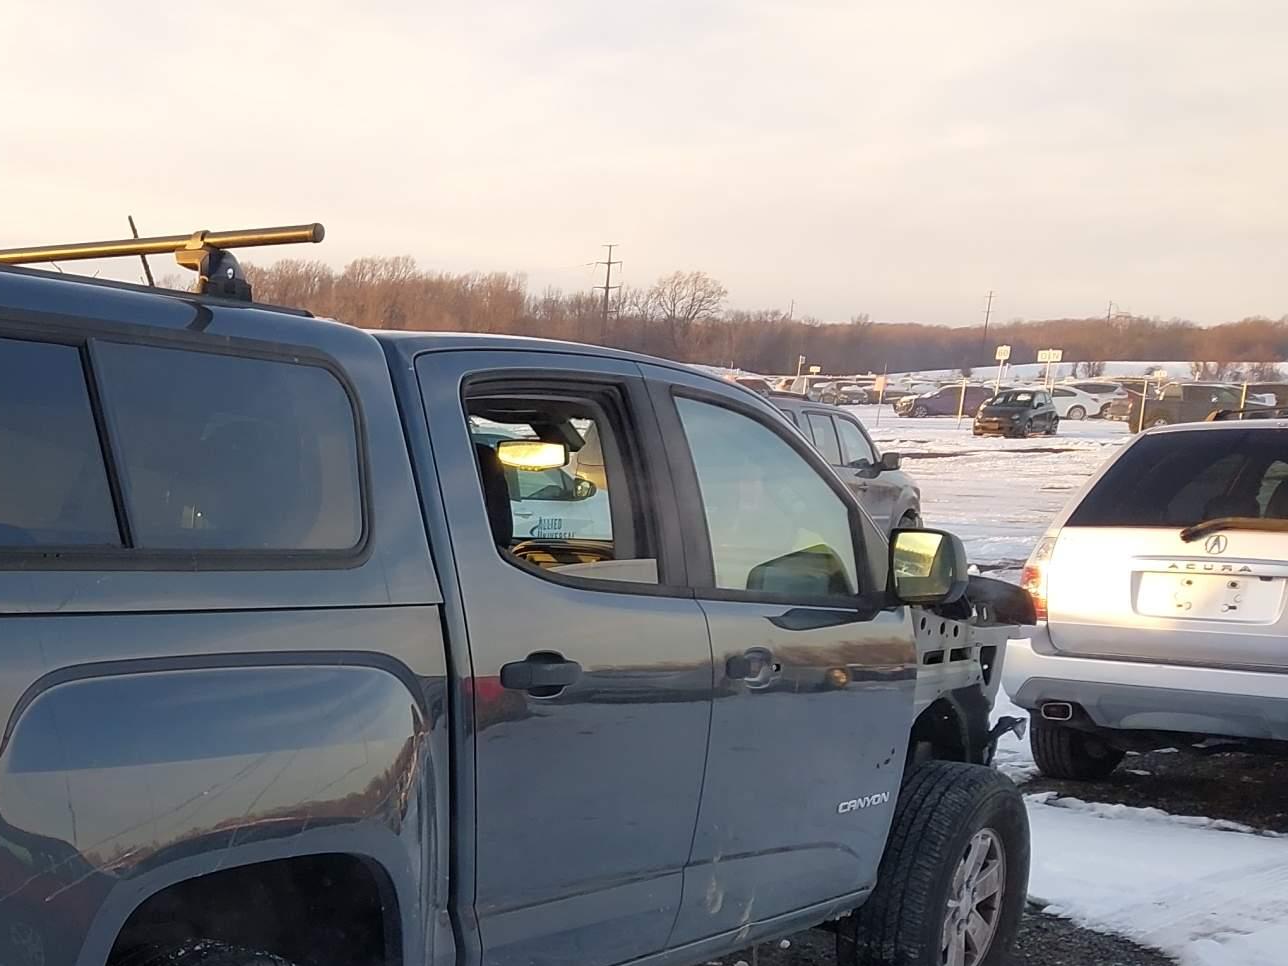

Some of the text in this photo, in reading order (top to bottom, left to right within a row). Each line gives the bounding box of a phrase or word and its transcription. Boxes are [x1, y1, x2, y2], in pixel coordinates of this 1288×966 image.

[538, 516, 562, 530] ALLIED
[1168, 563, 1252, 572] ACURA
[838, 791, 890, 813] CANYON
